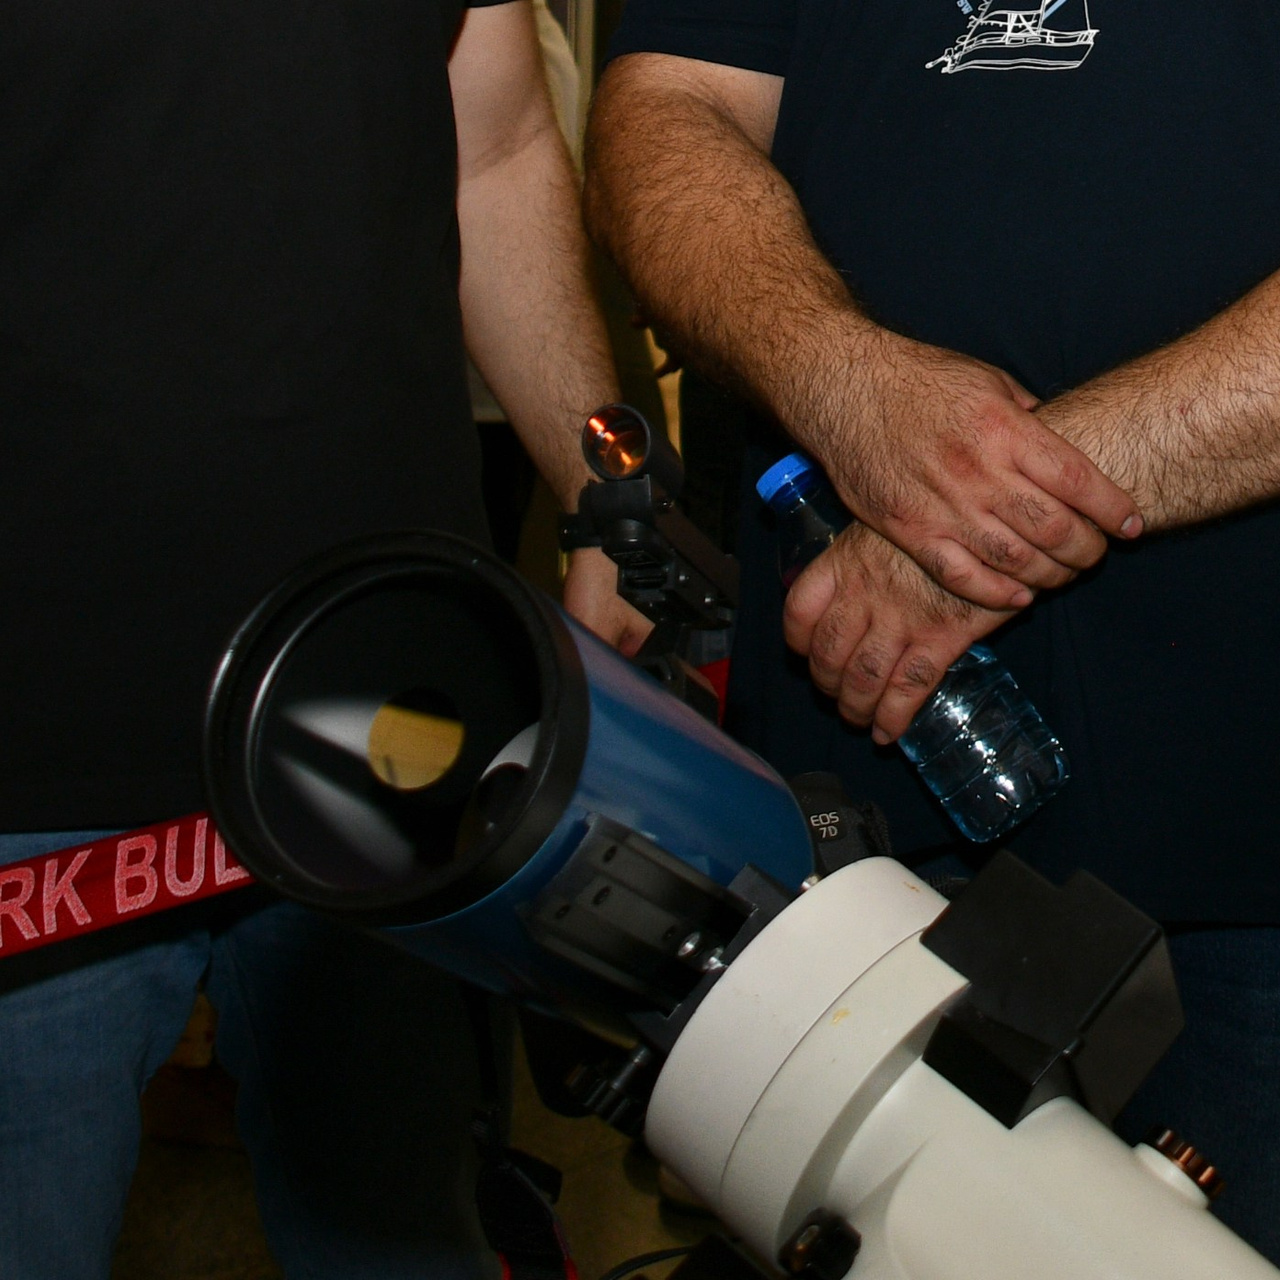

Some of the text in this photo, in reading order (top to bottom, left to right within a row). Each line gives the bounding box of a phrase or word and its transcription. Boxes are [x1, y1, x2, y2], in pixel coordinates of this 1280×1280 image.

[810, 811, 839, 827] EOS
[819, 825, 838, 838] 7D
[0, 817, 250, 948] RK BUL
